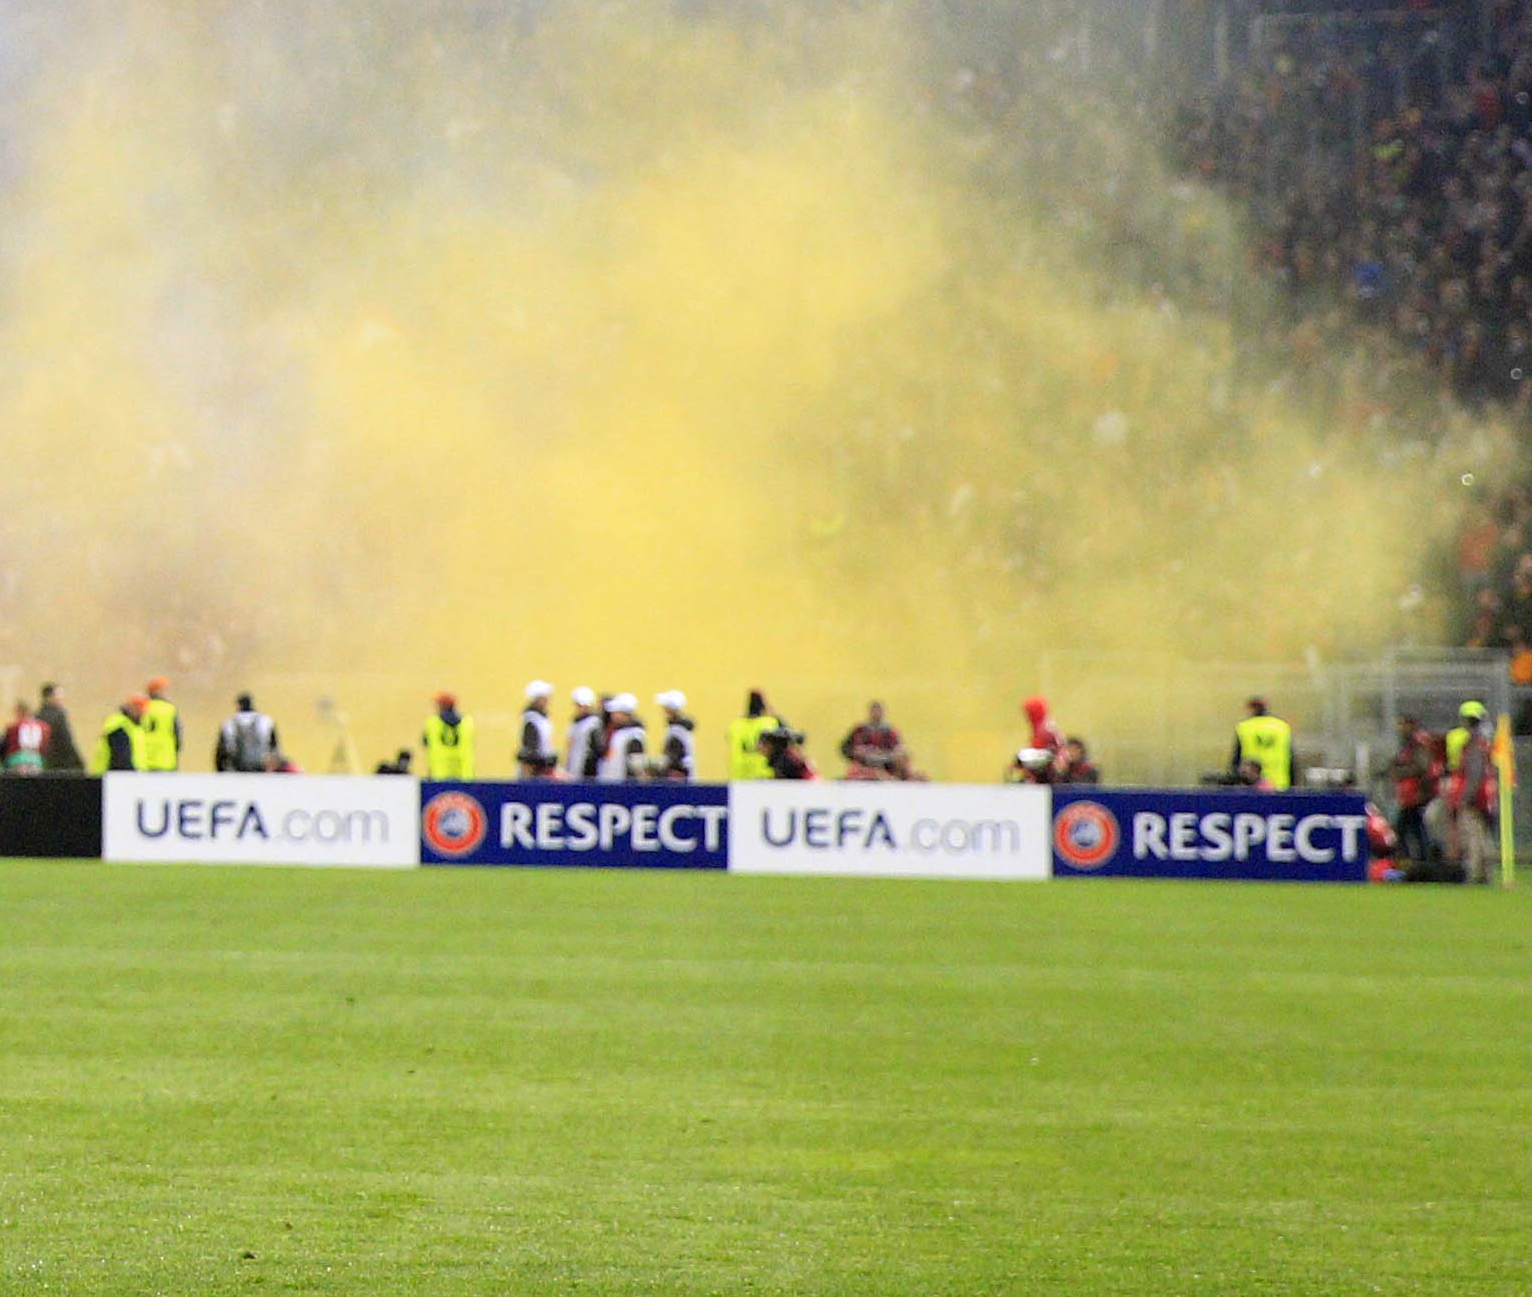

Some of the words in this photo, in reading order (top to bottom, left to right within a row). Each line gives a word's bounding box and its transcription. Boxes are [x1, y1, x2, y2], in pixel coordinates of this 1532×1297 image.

[136, 797, 390, 844] UEFA.com
[499, 801, 728, 852] RESPECT
[760, 806, 1020, 854] UEFA.com
[1133, 811, 1366, 865] RESPECT
